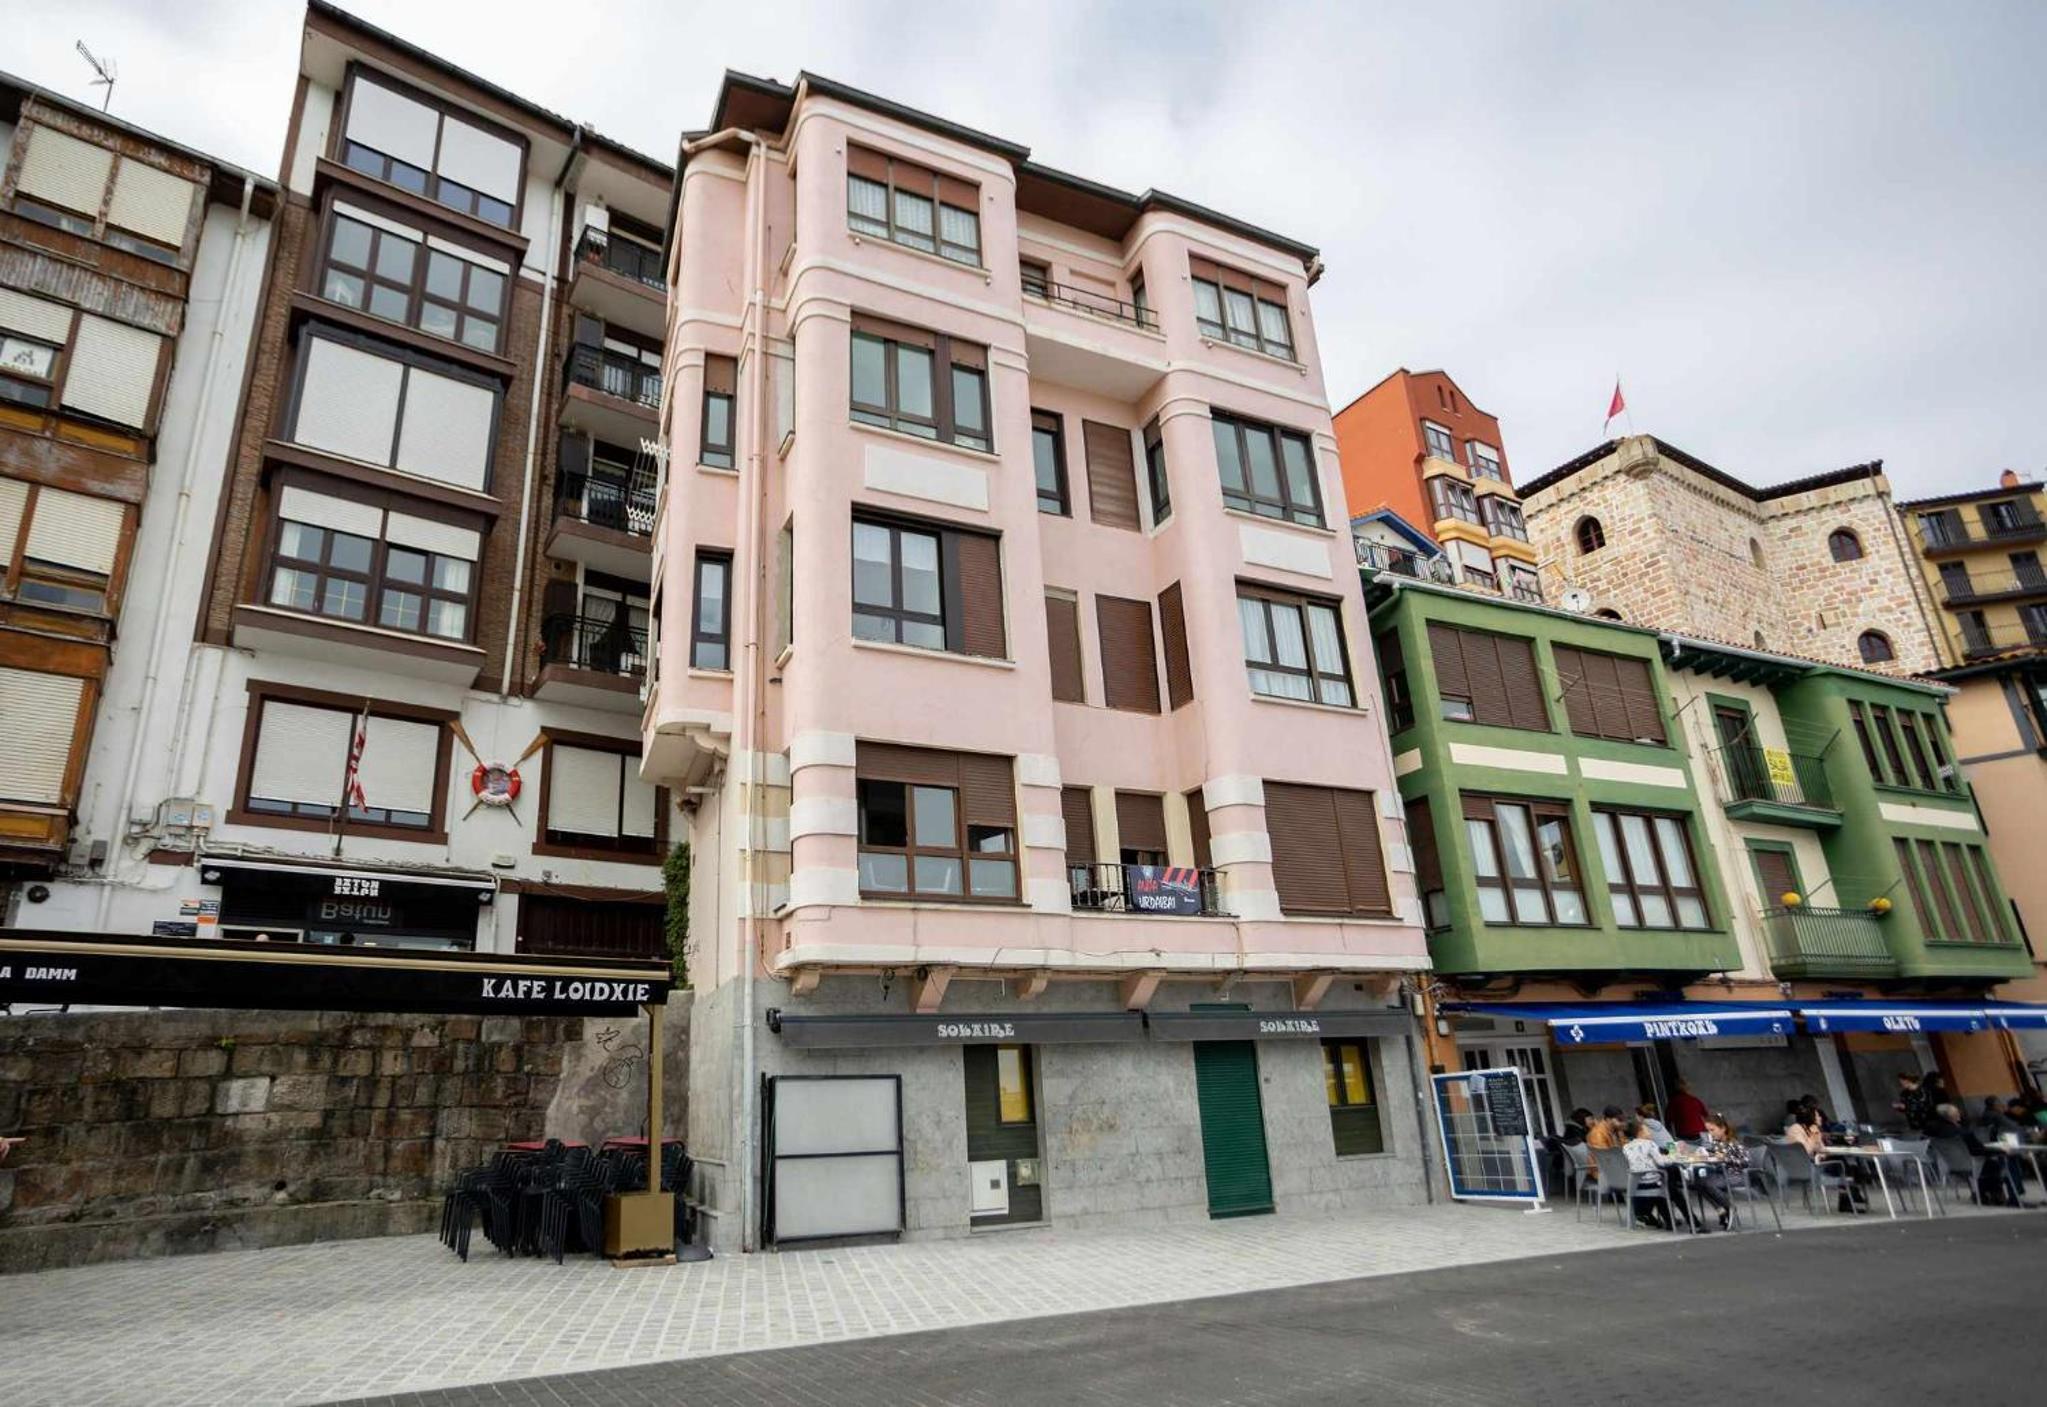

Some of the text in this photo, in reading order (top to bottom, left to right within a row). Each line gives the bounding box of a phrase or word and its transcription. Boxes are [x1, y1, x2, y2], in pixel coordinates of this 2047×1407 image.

[25, 967, 77, 980] DAMM
[482, 978, 650, 1001] KAFE LOIDXIE
